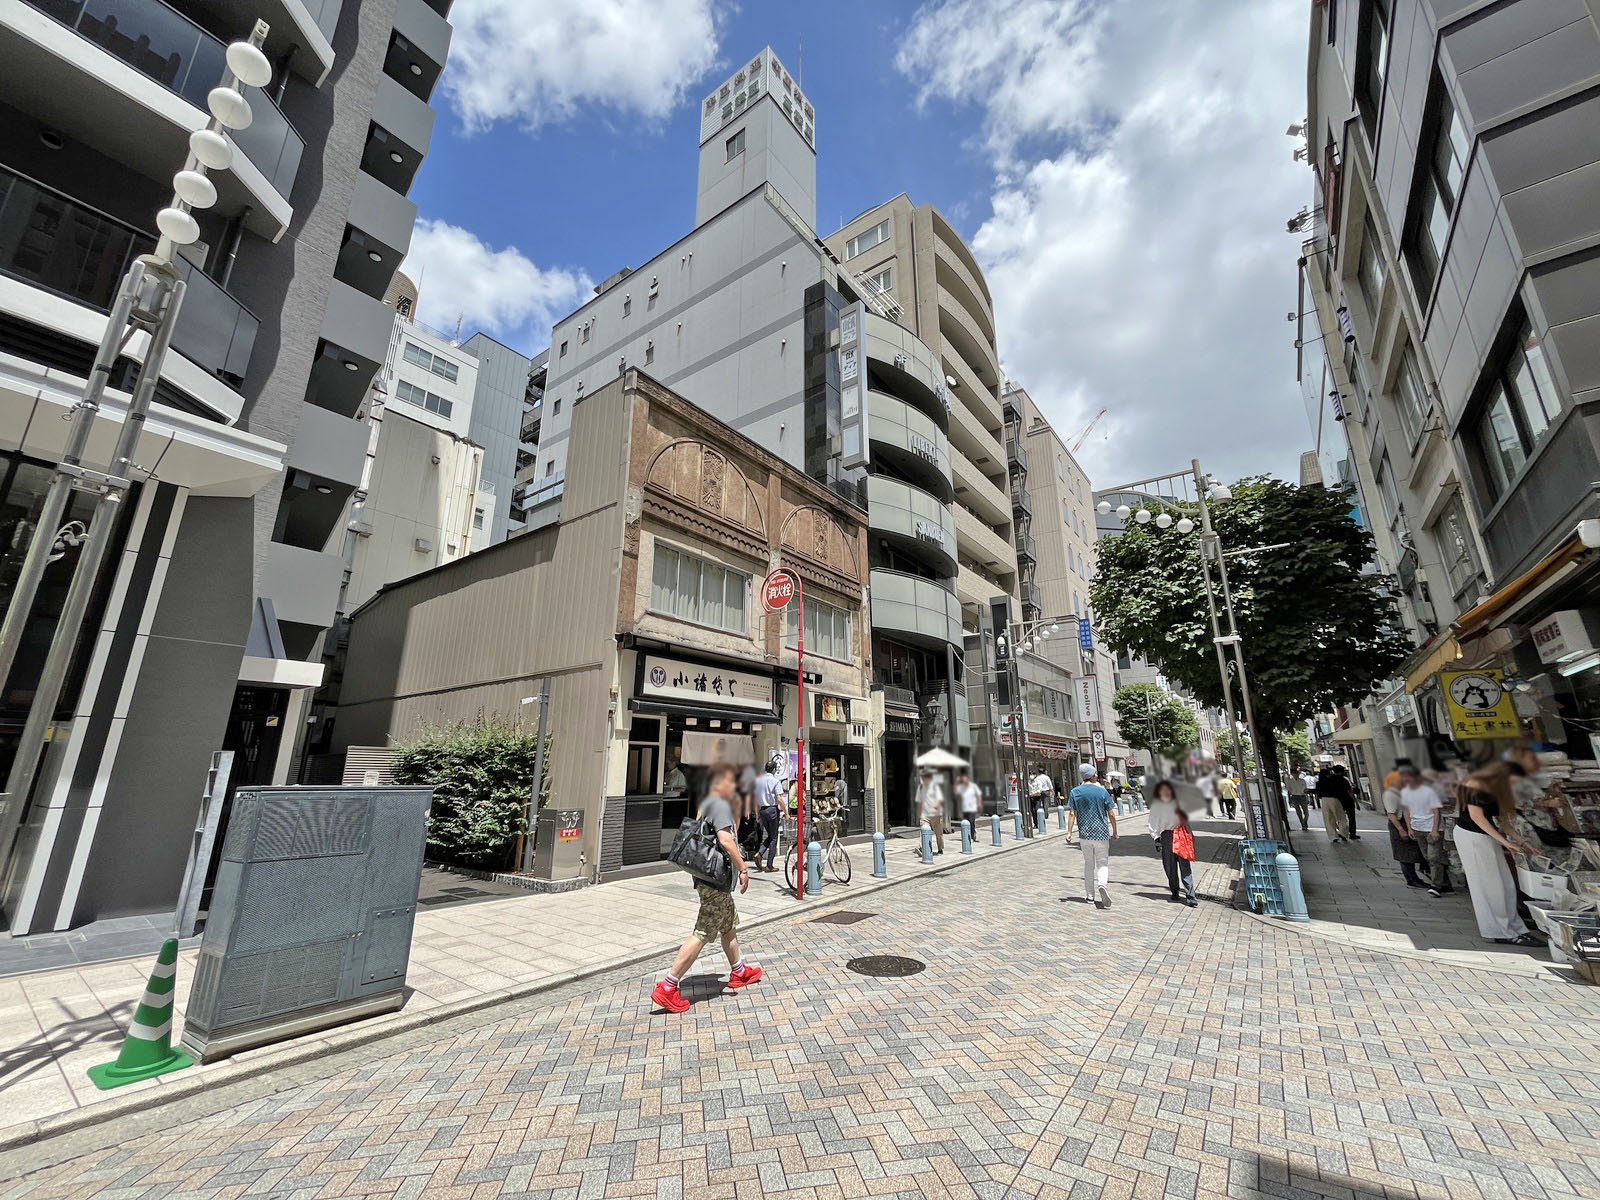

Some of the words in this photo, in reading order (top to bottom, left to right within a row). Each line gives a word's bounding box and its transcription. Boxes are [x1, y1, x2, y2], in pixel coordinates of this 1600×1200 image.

[768, 582, 791, 600] 消火栓
[1083, 681, 1091, 717] Neolive
